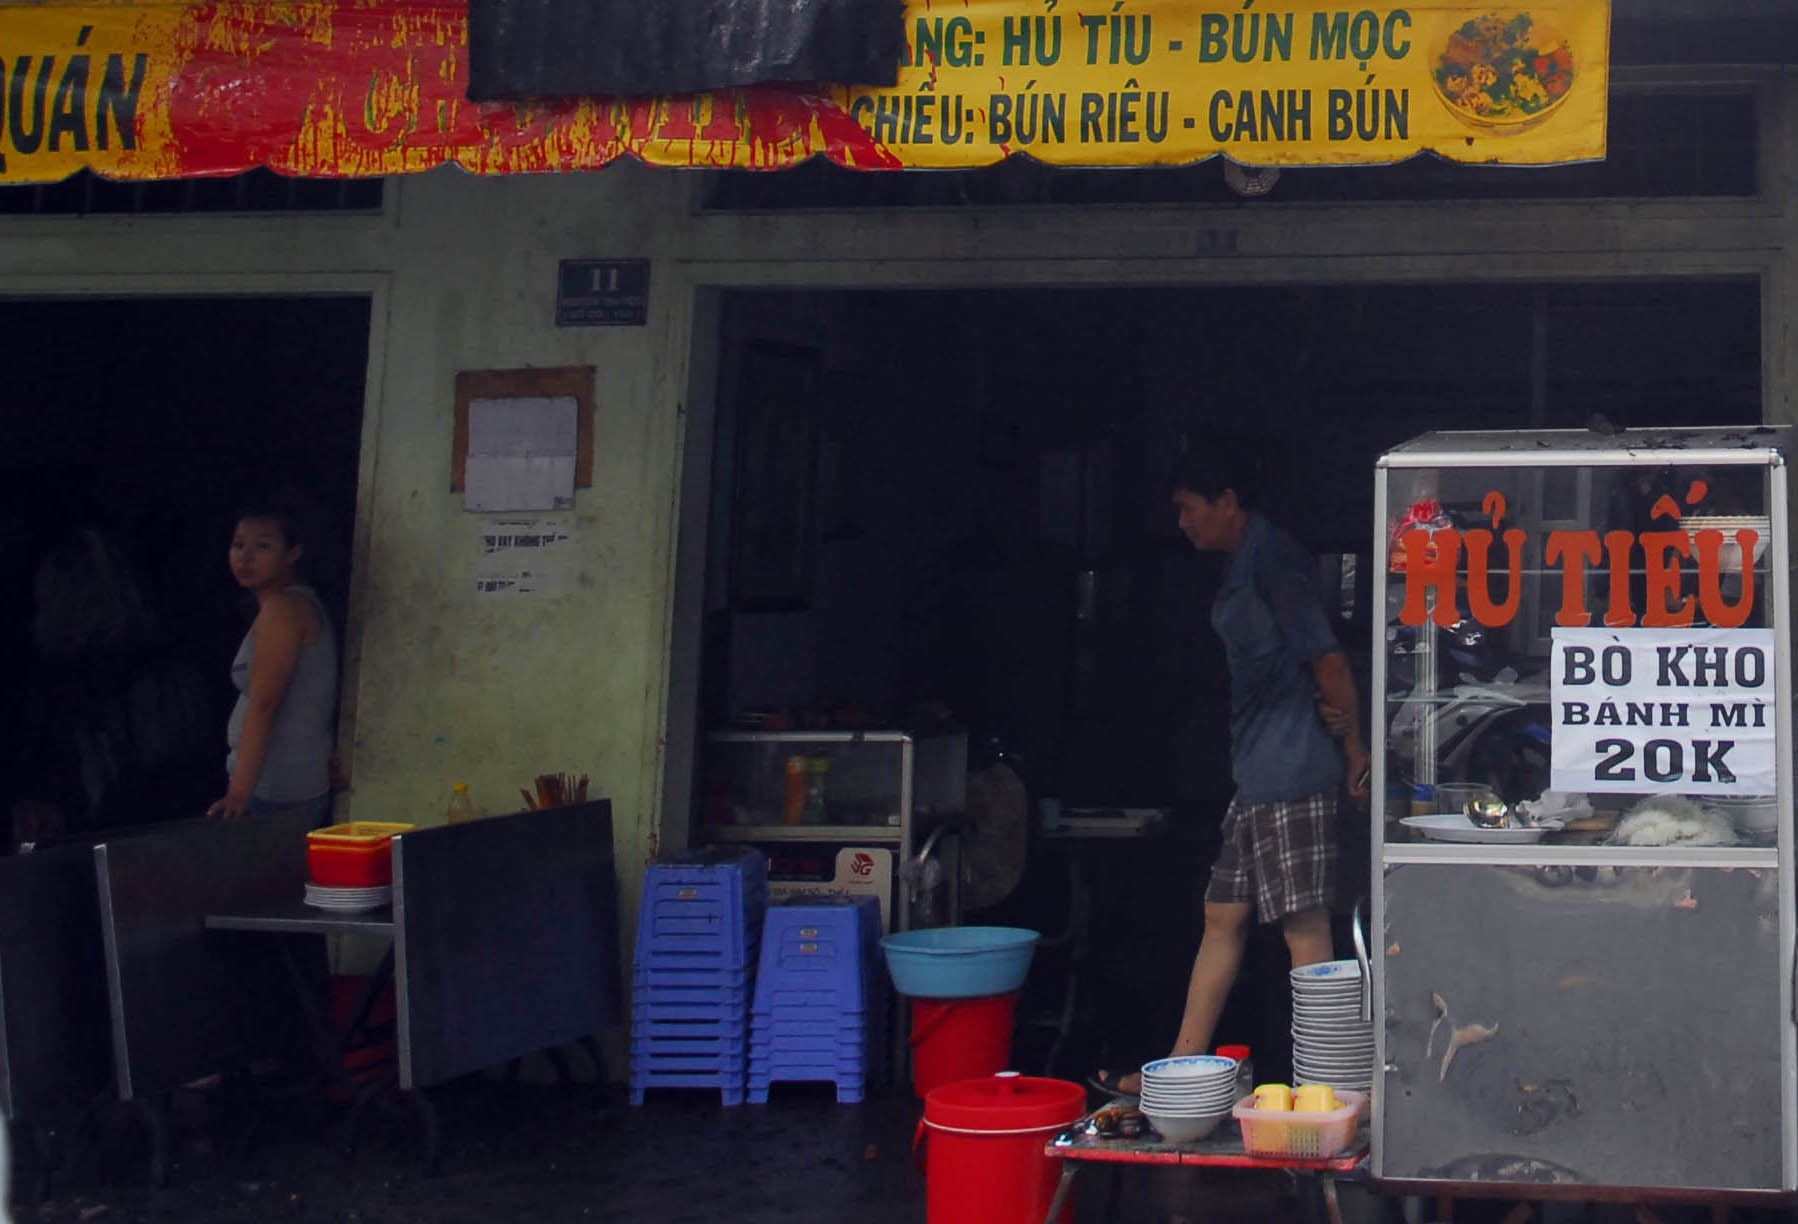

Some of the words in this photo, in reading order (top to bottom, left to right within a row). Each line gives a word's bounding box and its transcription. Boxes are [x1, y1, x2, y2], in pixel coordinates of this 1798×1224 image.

[1083, 1, 1152, 65] TÍU
[1199, 0, 1293, 63] BÚN
[1310, 9, 1412, 71] MỌC
[0, 25, 148, 174] UÁN
[989, 80, 1066, 145] BÚN
[1080, 79, 1169, 143] RIÊU
[1208, 89, 1312, 142] CANH
[1328, 74, 1409, 141] BÚN
[590, 268, 619, 291] 11
[1400, 490, 1528, 627] HỦ
[1545, 480, 1760, 627] TIẾU
[1562, 635, 1632, 687] BÒ
[1656, 644, 1765, 688] KHO
[1562, 696, 1690, 727] BÁNH
[1710, 698, 1766, 727] MÌ
[1594, 738, 1737, 783] 20K
